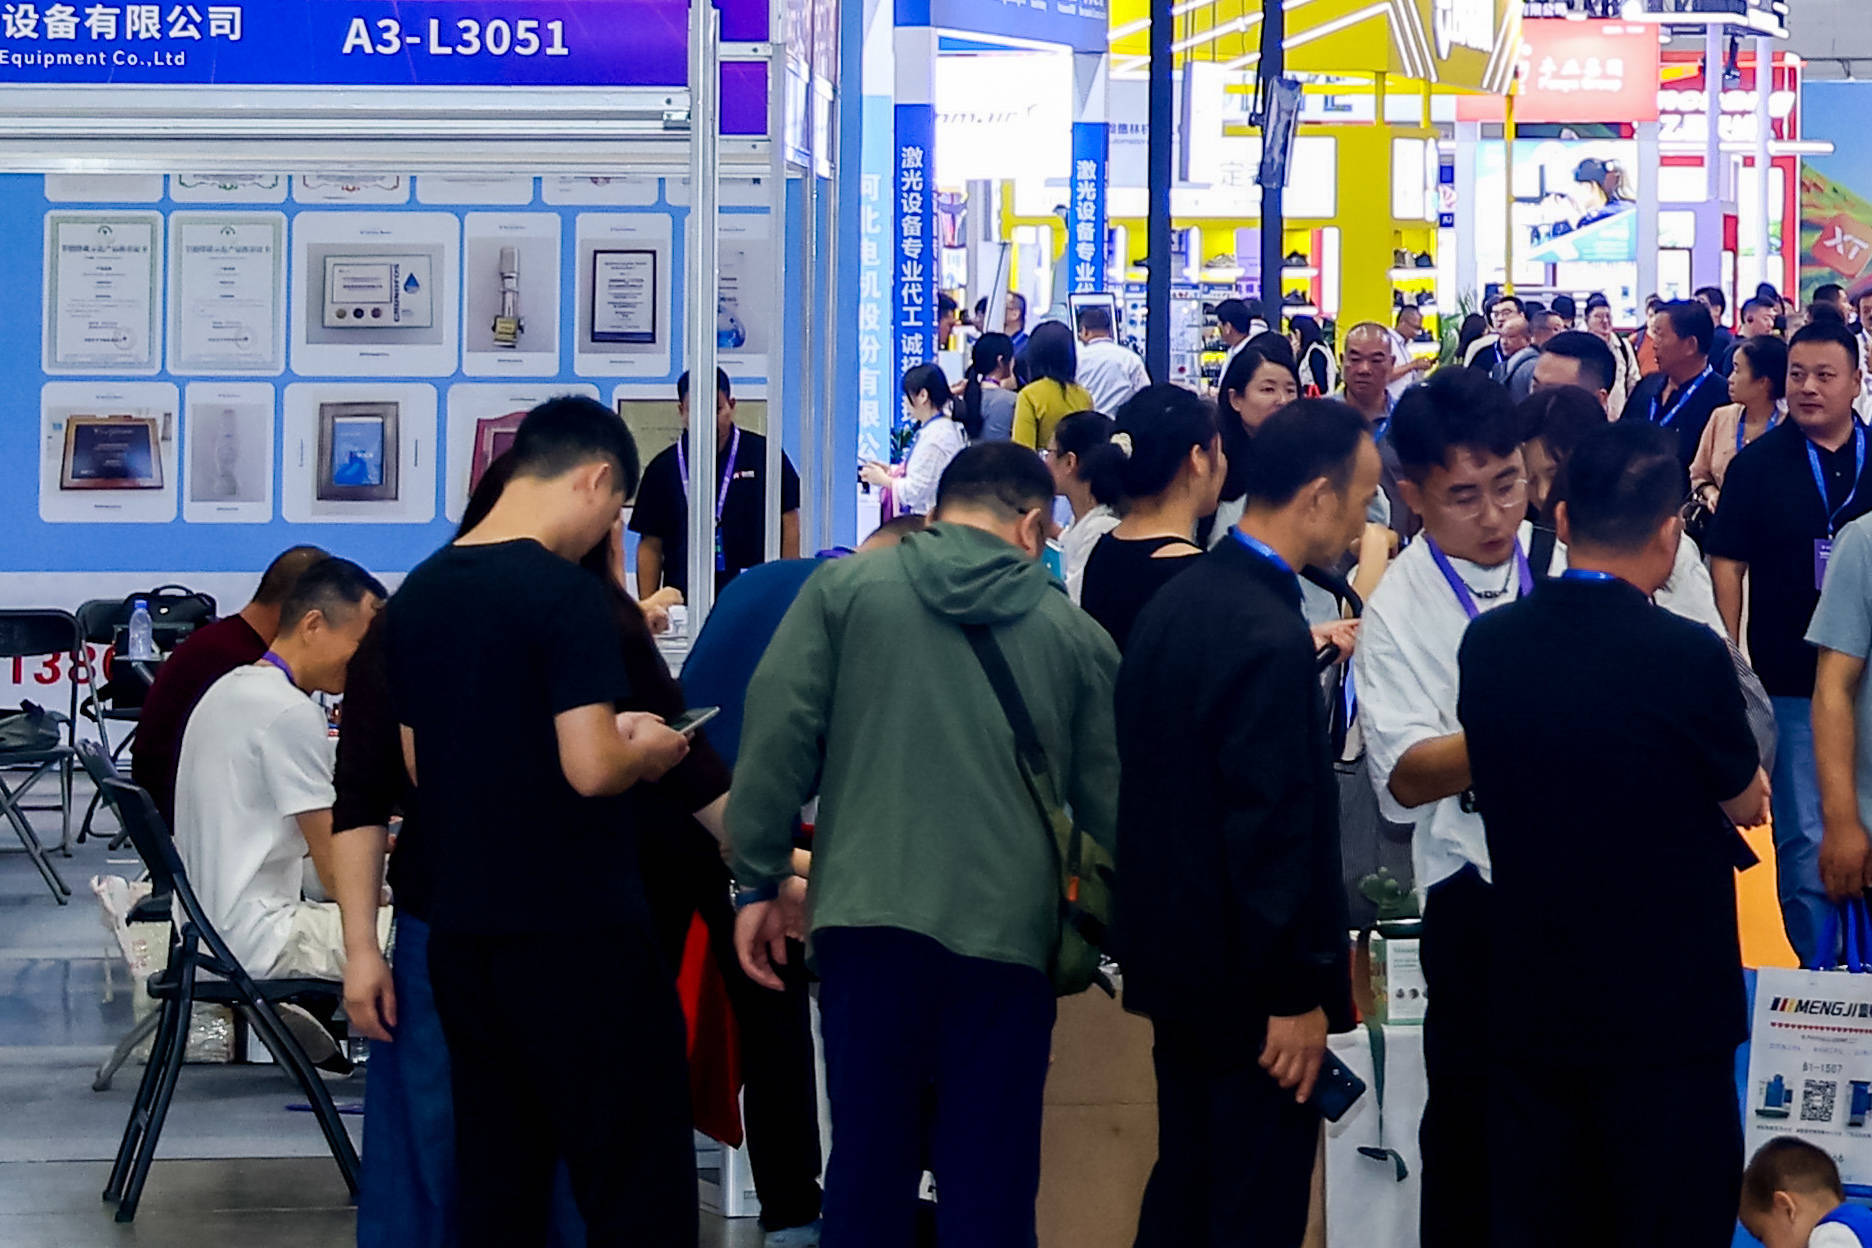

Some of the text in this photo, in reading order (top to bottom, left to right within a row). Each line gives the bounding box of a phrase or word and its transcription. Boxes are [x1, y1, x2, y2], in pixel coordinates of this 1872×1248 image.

[2, 3, 244, 41] 设备有限公司
[343, 18, 570, 56] A3-L3051
[0, 50, 107, 69] Equipment
